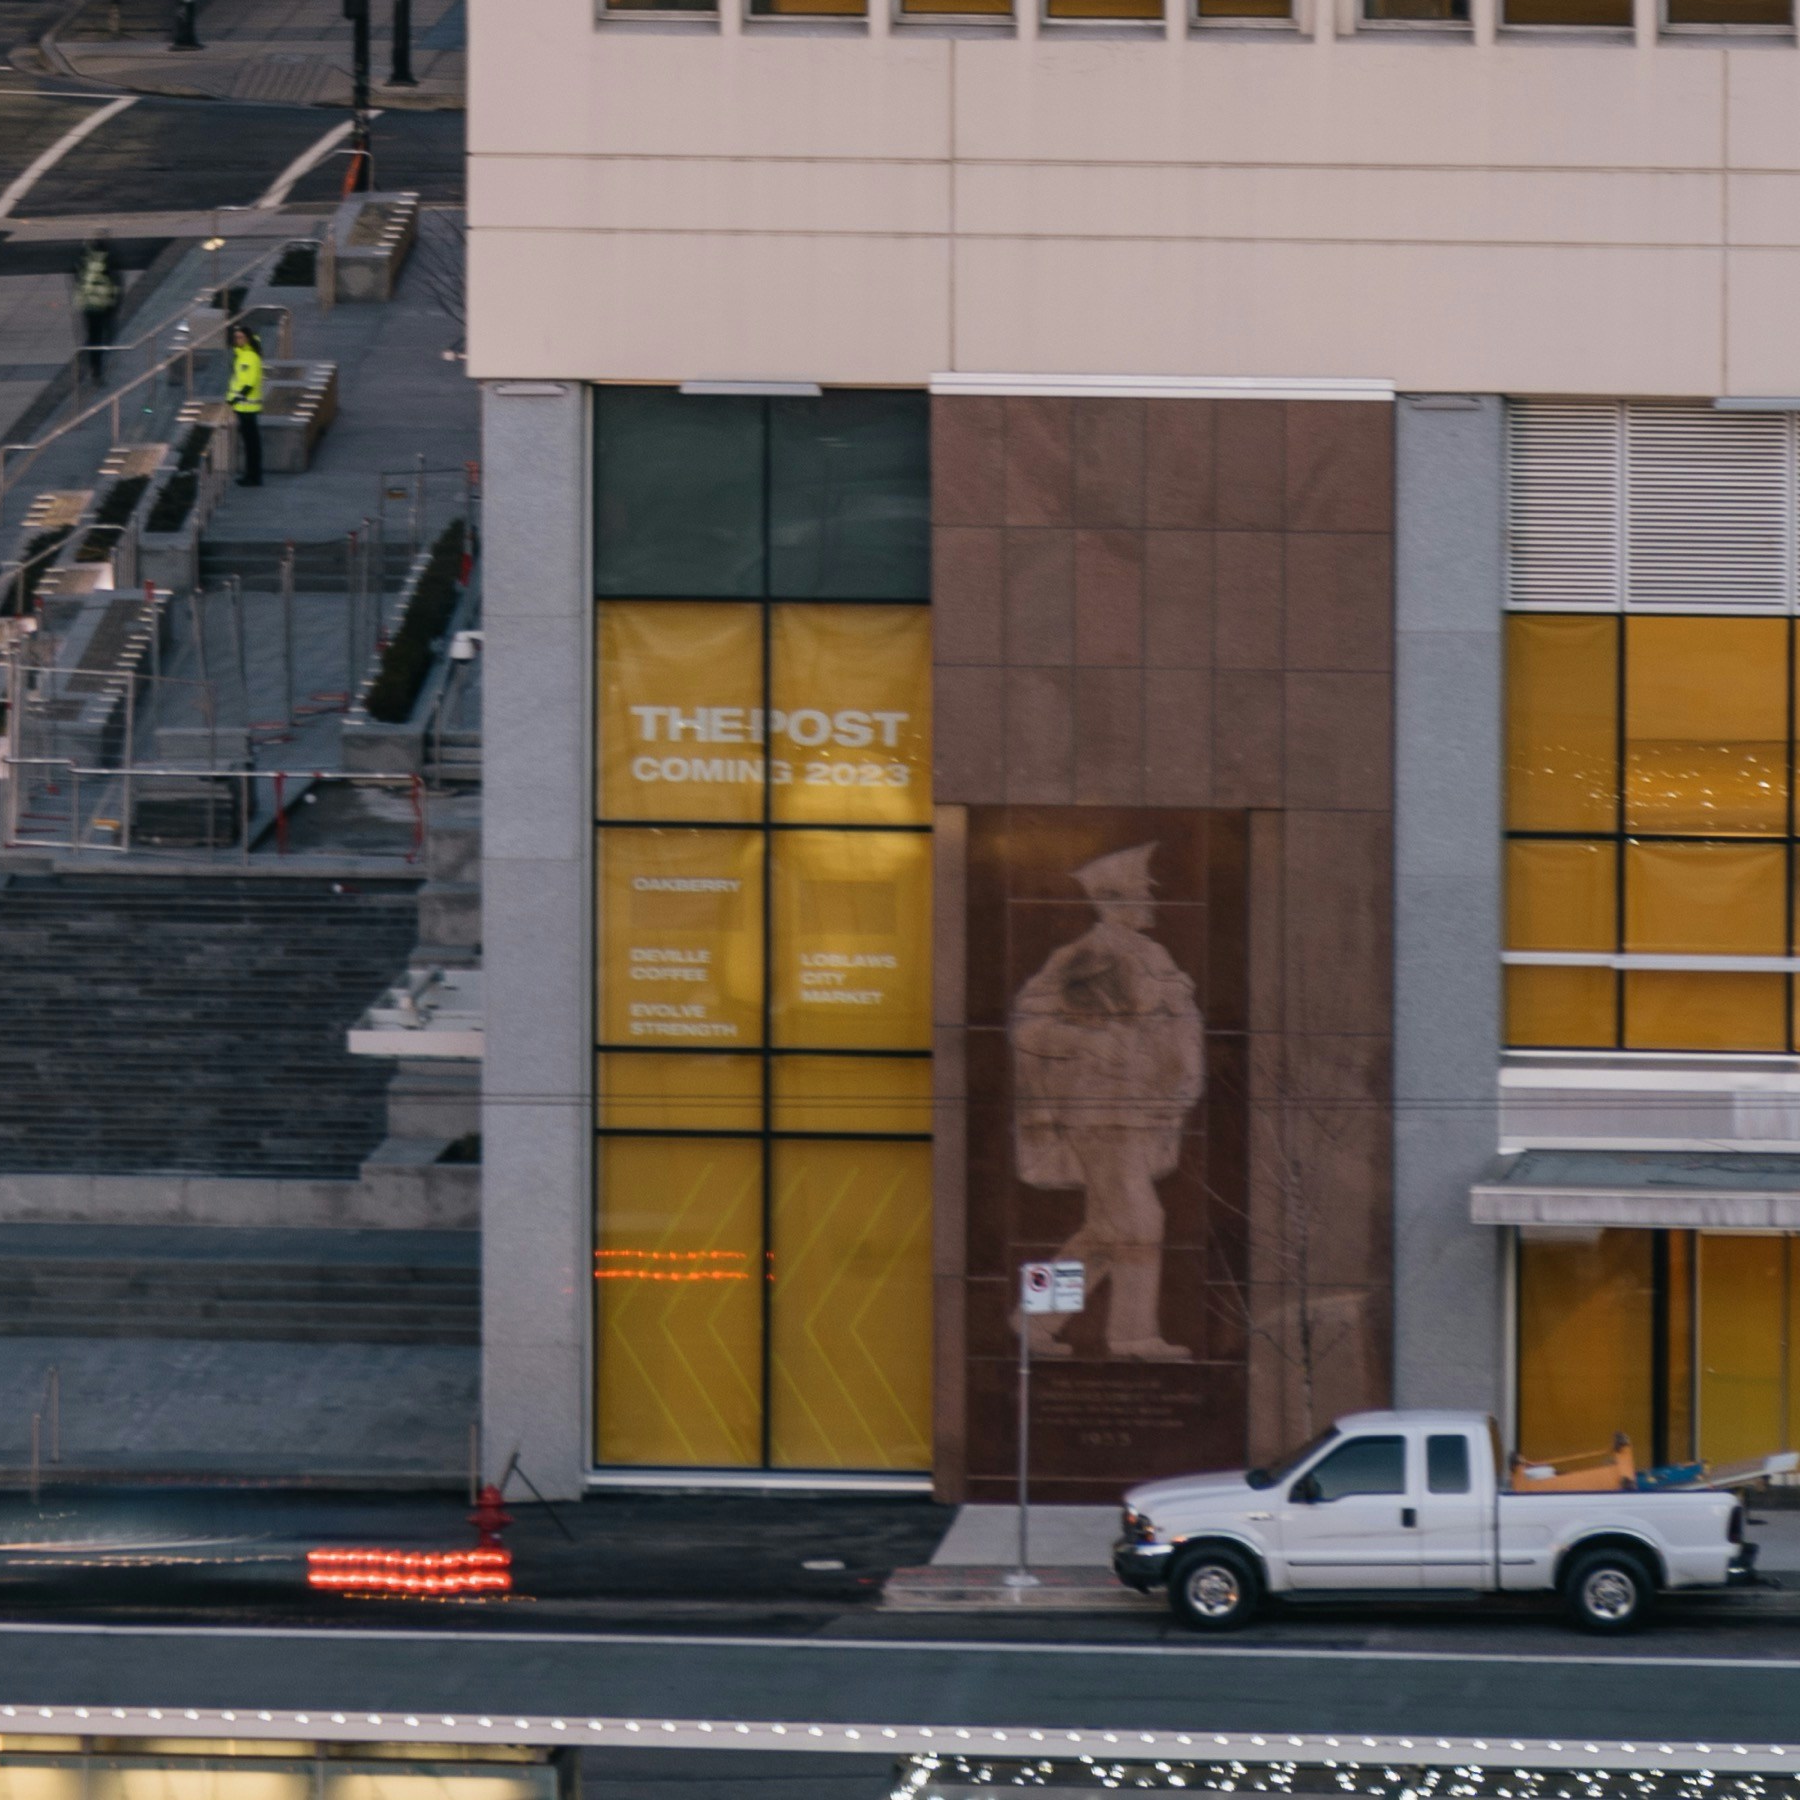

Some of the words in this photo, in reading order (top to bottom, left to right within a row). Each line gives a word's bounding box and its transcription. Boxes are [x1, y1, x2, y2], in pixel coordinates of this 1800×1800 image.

[630, 705, 745, 743] THE
[751, 708, 909, 748] POST
[631, 756, 794, 785] COMING
[805, 761, 911, 787] 2023
[632, 877, 741, 892] OAKBERRY
[630, 948, 711, 964] DEVILLE
[630, 966, 708, 981] COFFEE
[630, 1003, 706, 1018] EVOLVE
[630, 1021, 738, 1037] STRENGTH
